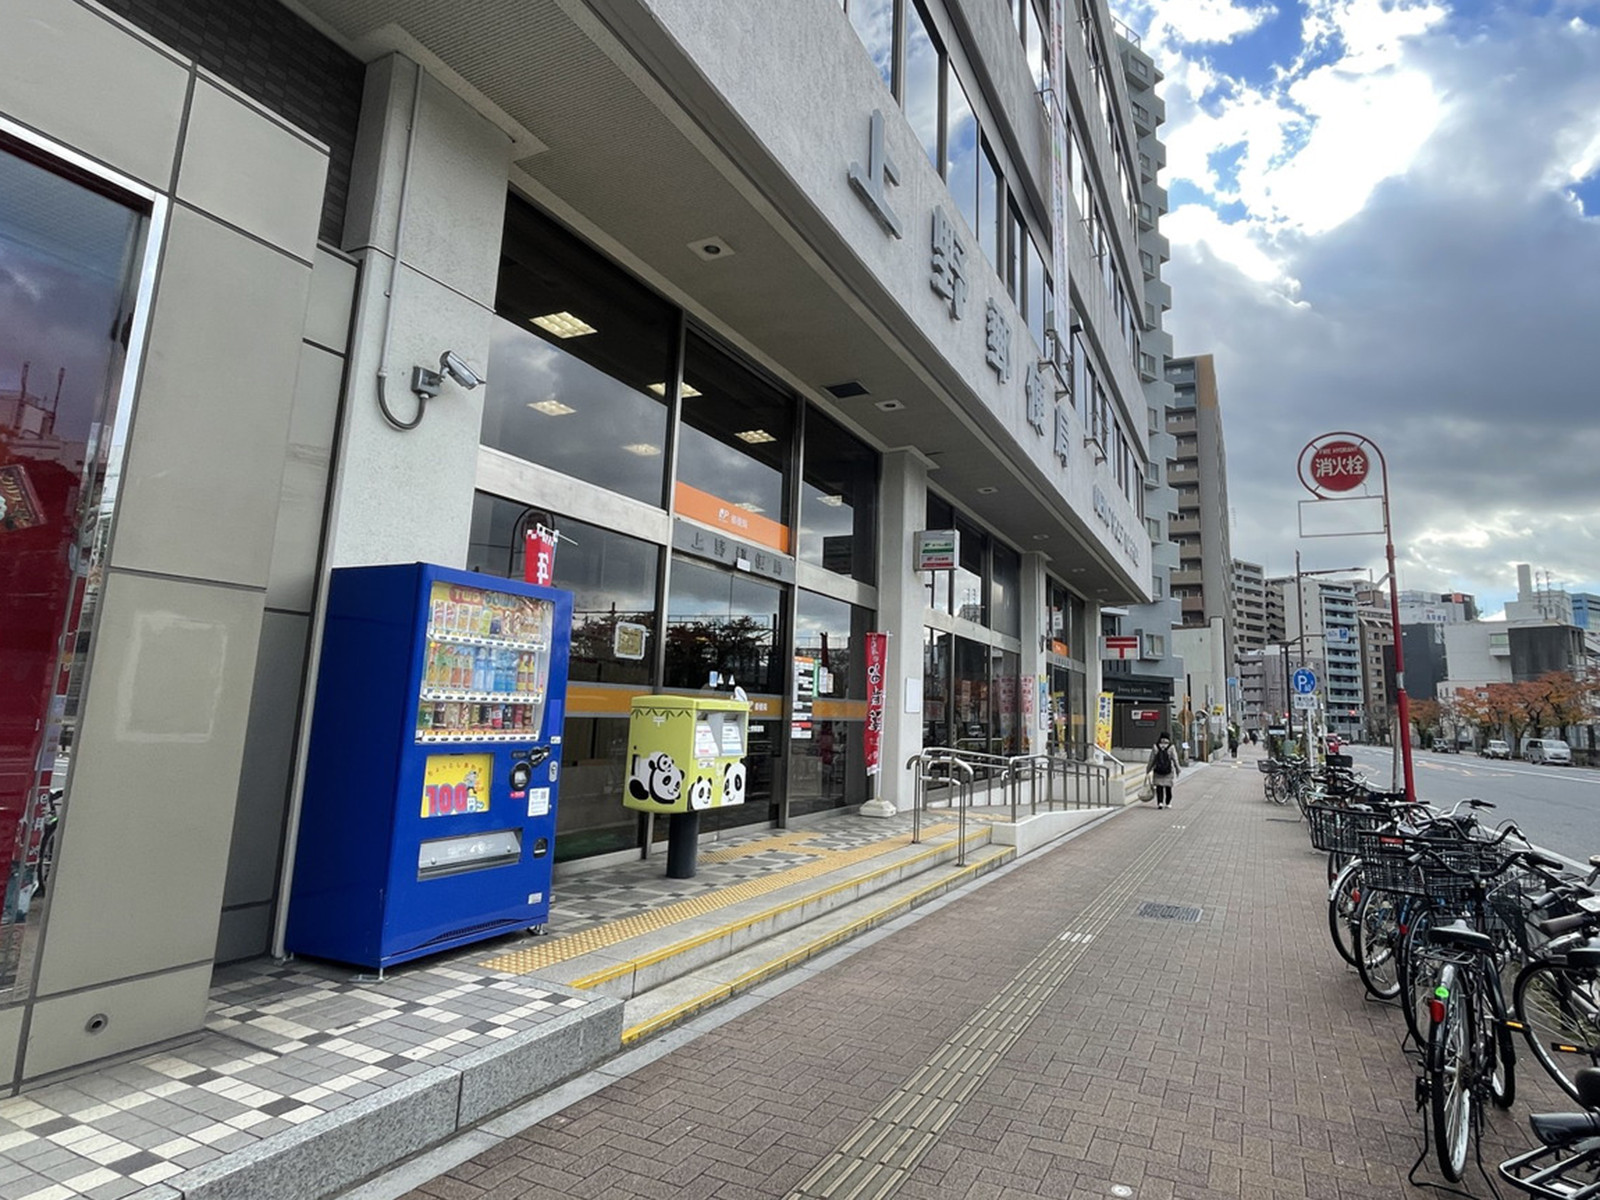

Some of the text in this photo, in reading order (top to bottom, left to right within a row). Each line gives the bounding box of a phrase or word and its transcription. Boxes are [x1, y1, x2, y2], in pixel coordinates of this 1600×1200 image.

[849, 109, 1070, 468] 上野郵便局
[1315, 455, 1365, 478] 消火栓
